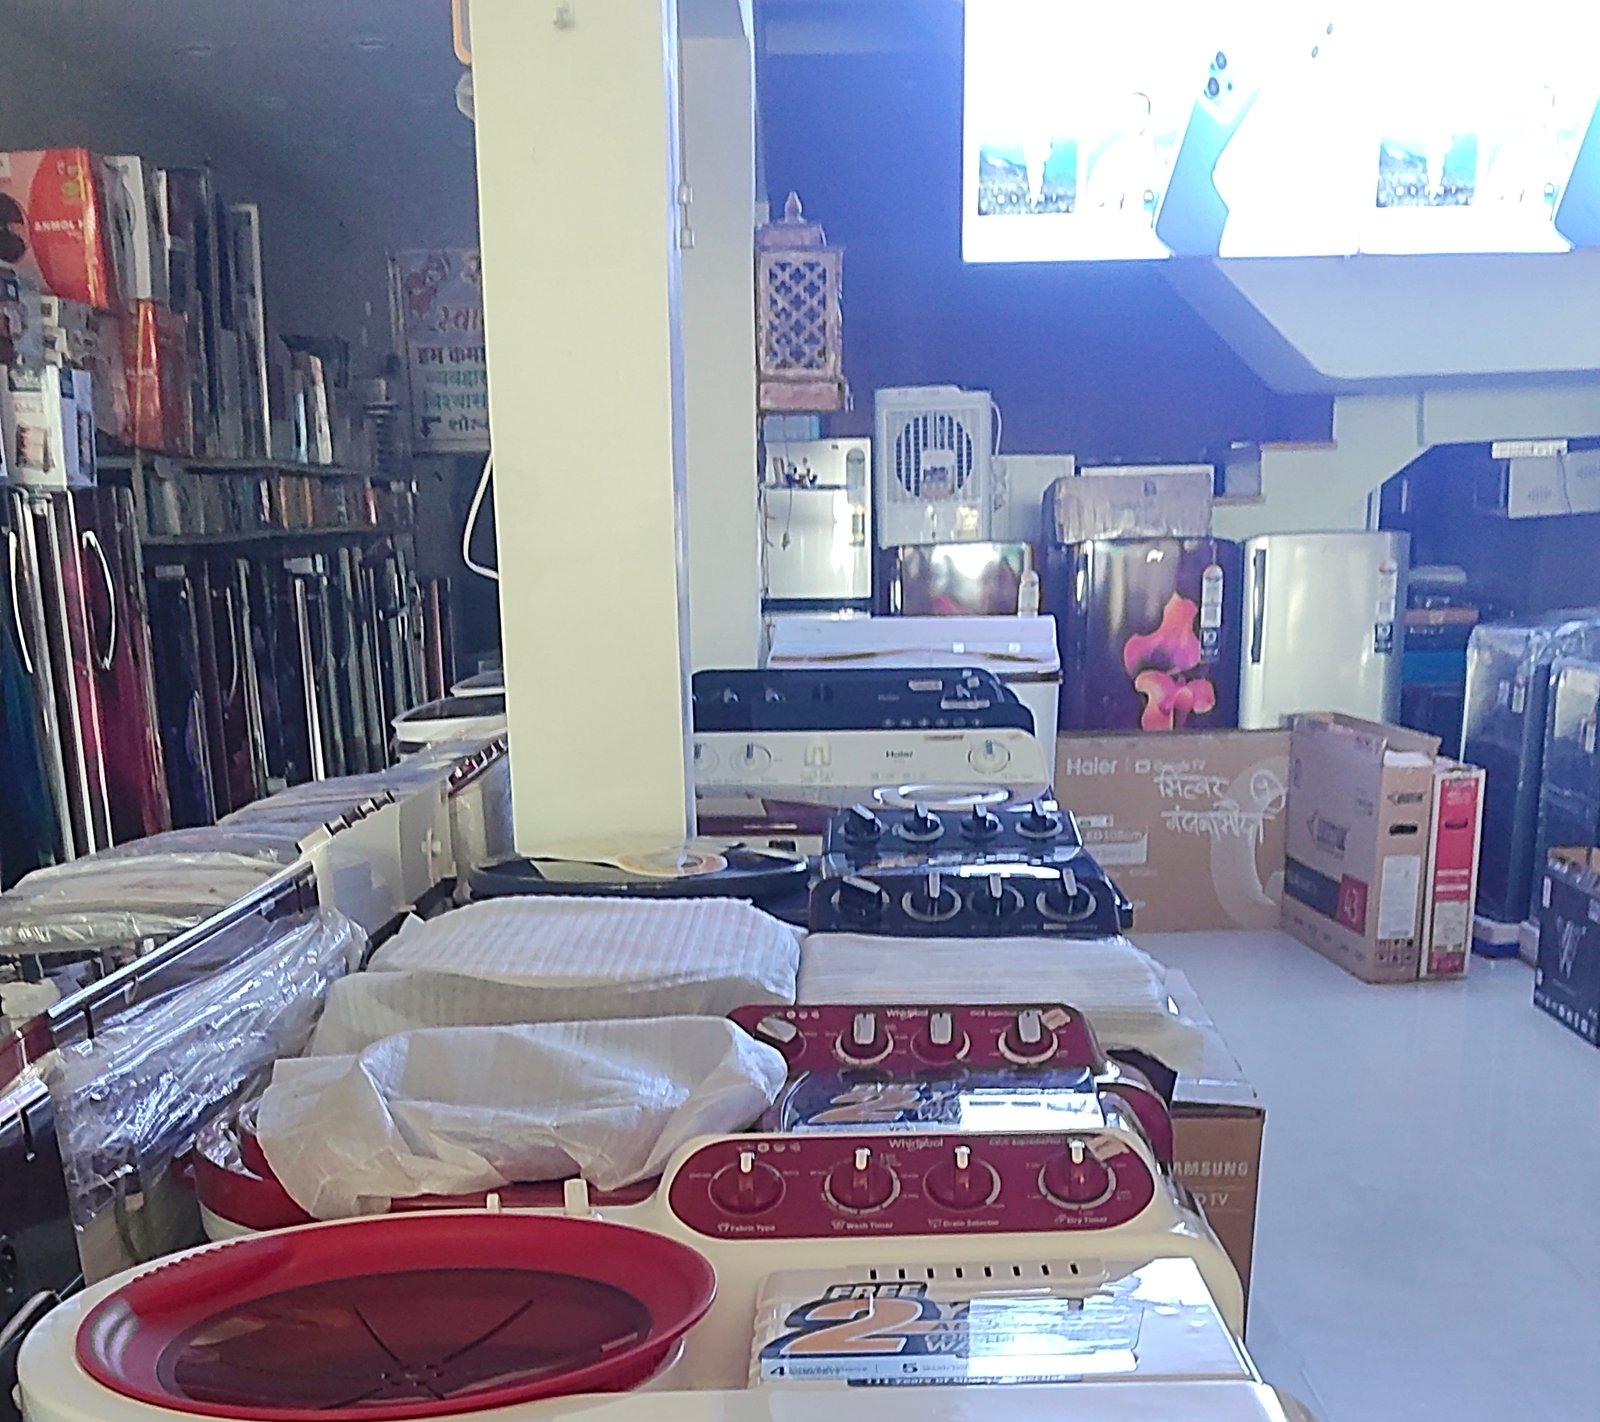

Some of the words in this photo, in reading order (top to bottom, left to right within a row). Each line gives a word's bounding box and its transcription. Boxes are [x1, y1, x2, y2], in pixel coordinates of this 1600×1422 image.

[448, 346, 485, 365] कमा
[1066, 757, 1118, 776] Haier
[886, 1009, 929, 1021] Whirlpool
[888, 1138, 944, 1152] Whirlpool
[1172, 1160, 1249, 1177] AMSUNG
[1211, 1192, 1229, 1206] TV
[846, 1221, 868, 1230] Wash
[1066, 1215, 1082, 1225] Dry
[828, 1283, 923, 1299] FREE
[779, 1298, 924, 1355] 2
[769, 1366, 785, 1377] 4
[902, 1362, 920, 1374] 5
